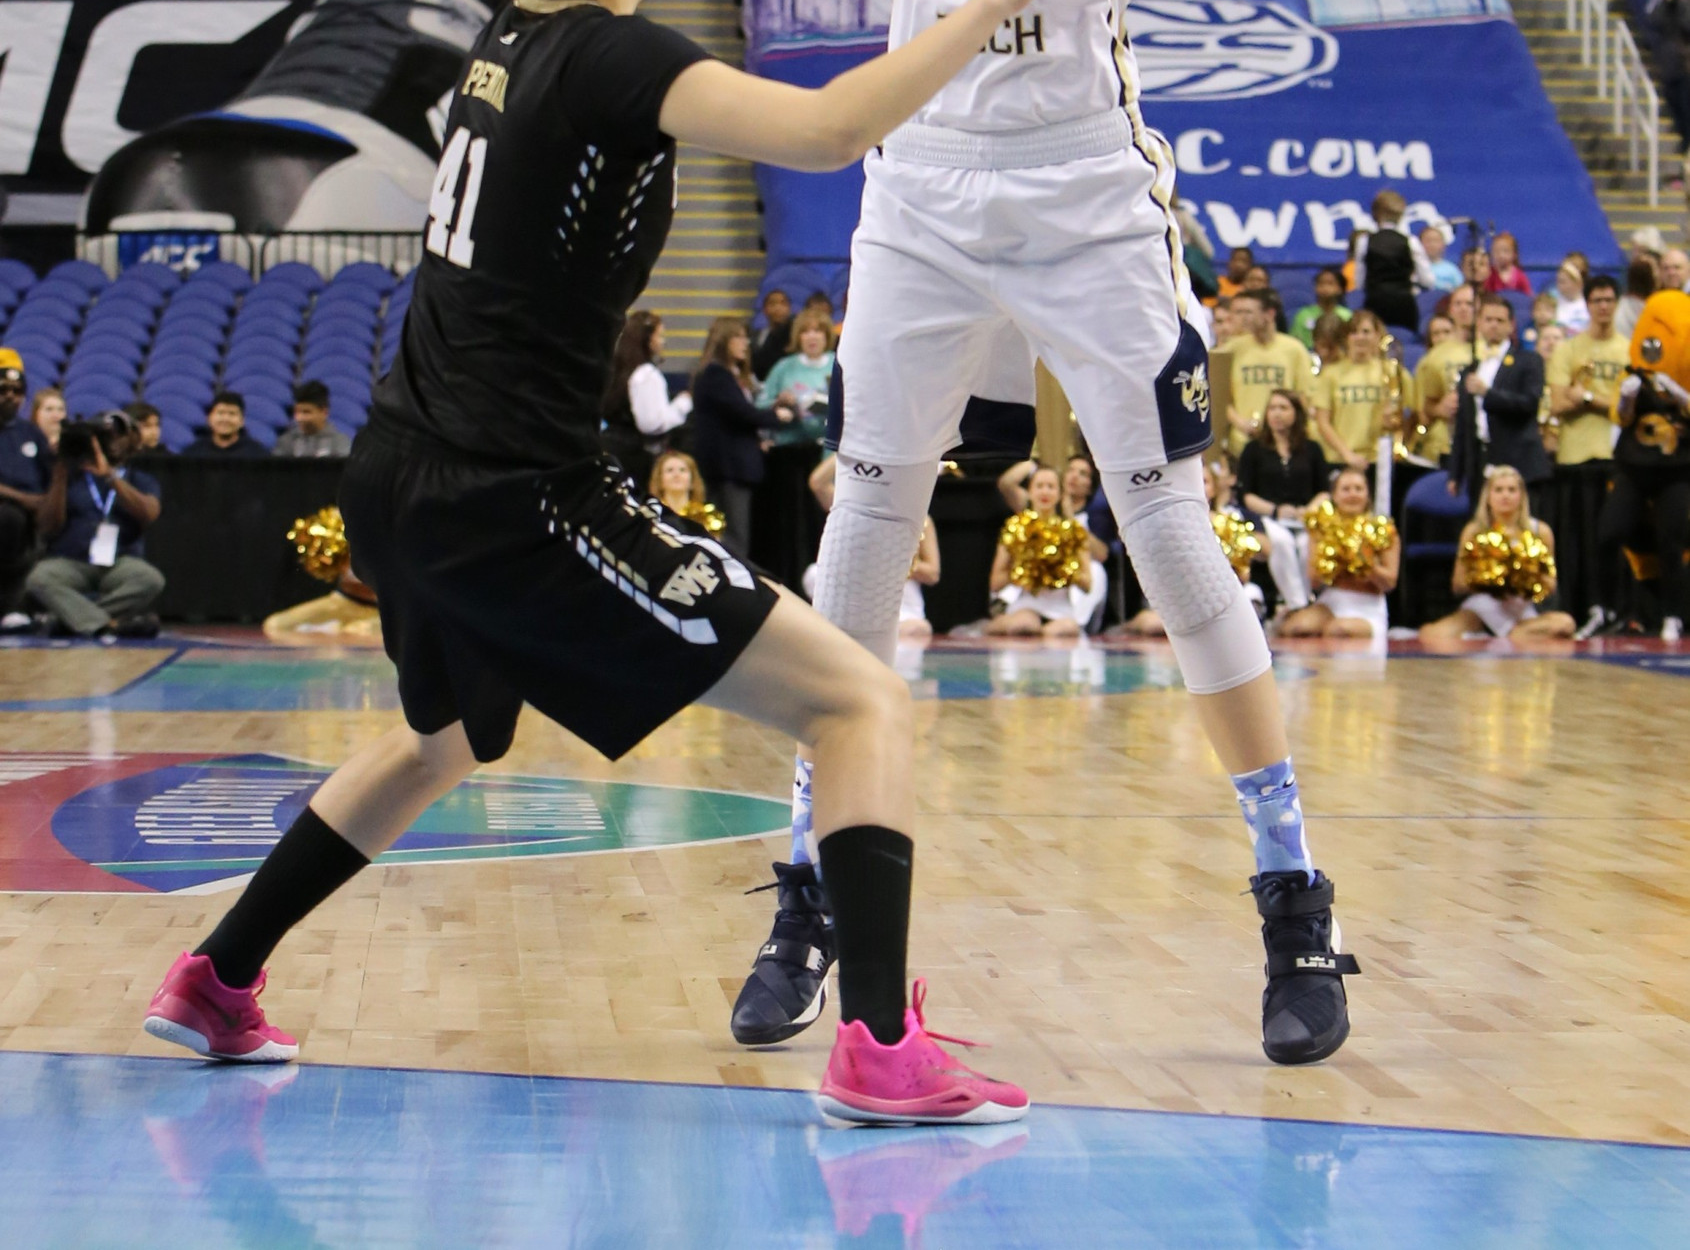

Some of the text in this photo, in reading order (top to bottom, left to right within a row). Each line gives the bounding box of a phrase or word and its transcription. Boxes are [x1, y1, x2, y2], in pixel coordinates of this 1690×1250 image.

[426, 125, 488, 270] 41
[1241, 365, 1286, 384] TECH
[659, 551, 720, 606] WF
